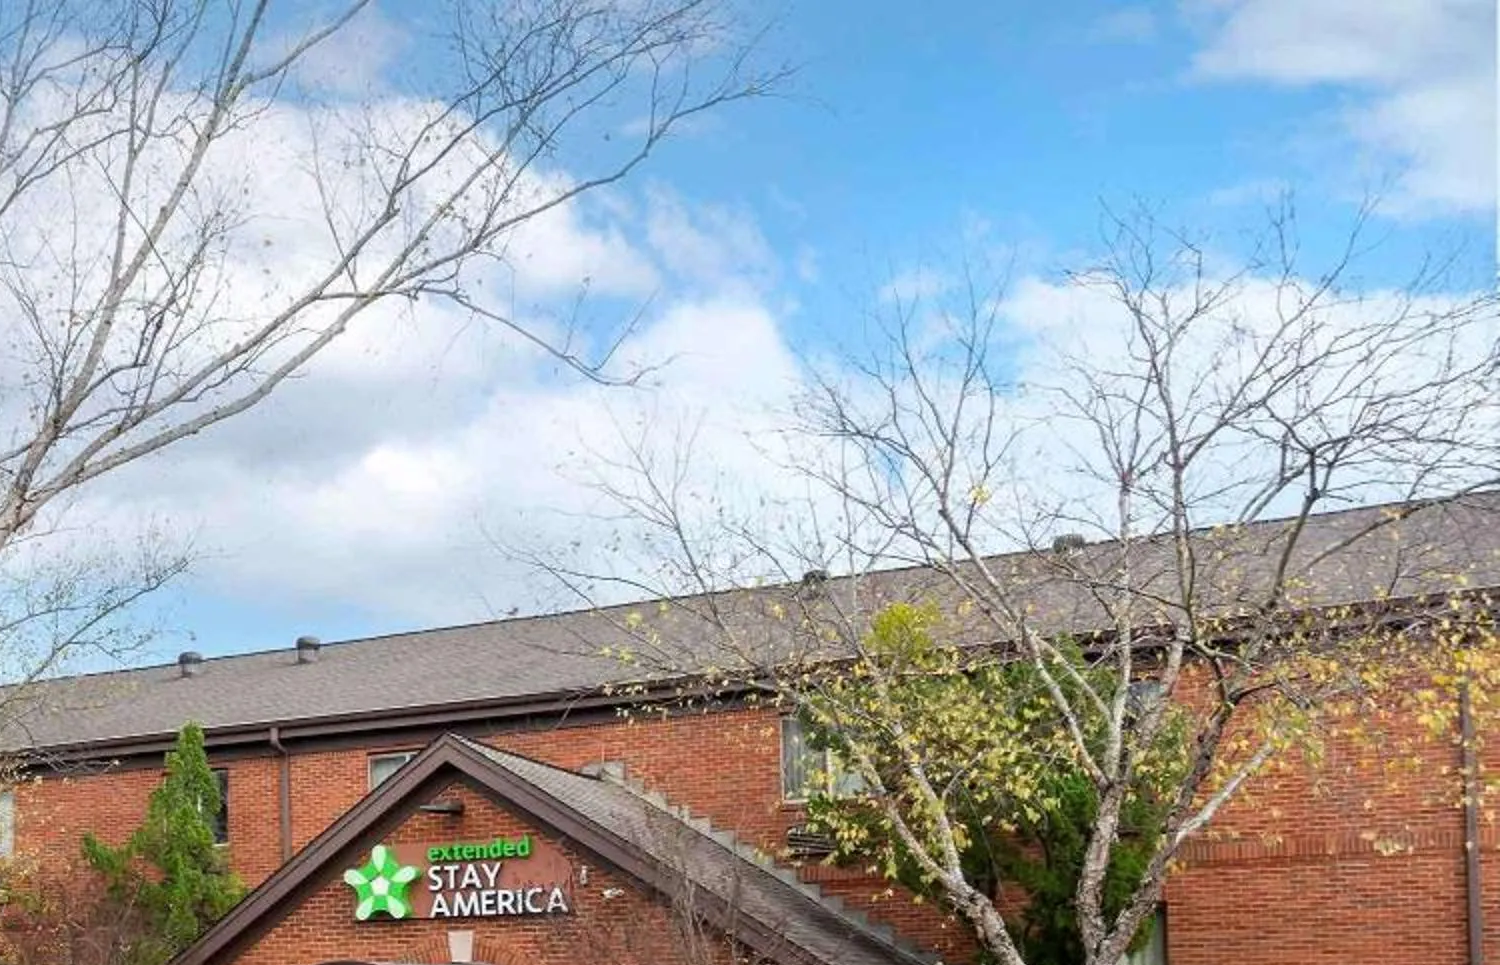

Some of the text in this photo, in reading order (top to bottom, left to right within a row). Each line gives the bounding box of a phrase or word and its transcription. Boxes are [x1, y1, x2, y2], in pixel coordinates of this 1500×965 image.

[428, 836, 531, 861] extended
[428, 862, 502, 891] STAY
[430, 888, 569, 918] AMERICA
